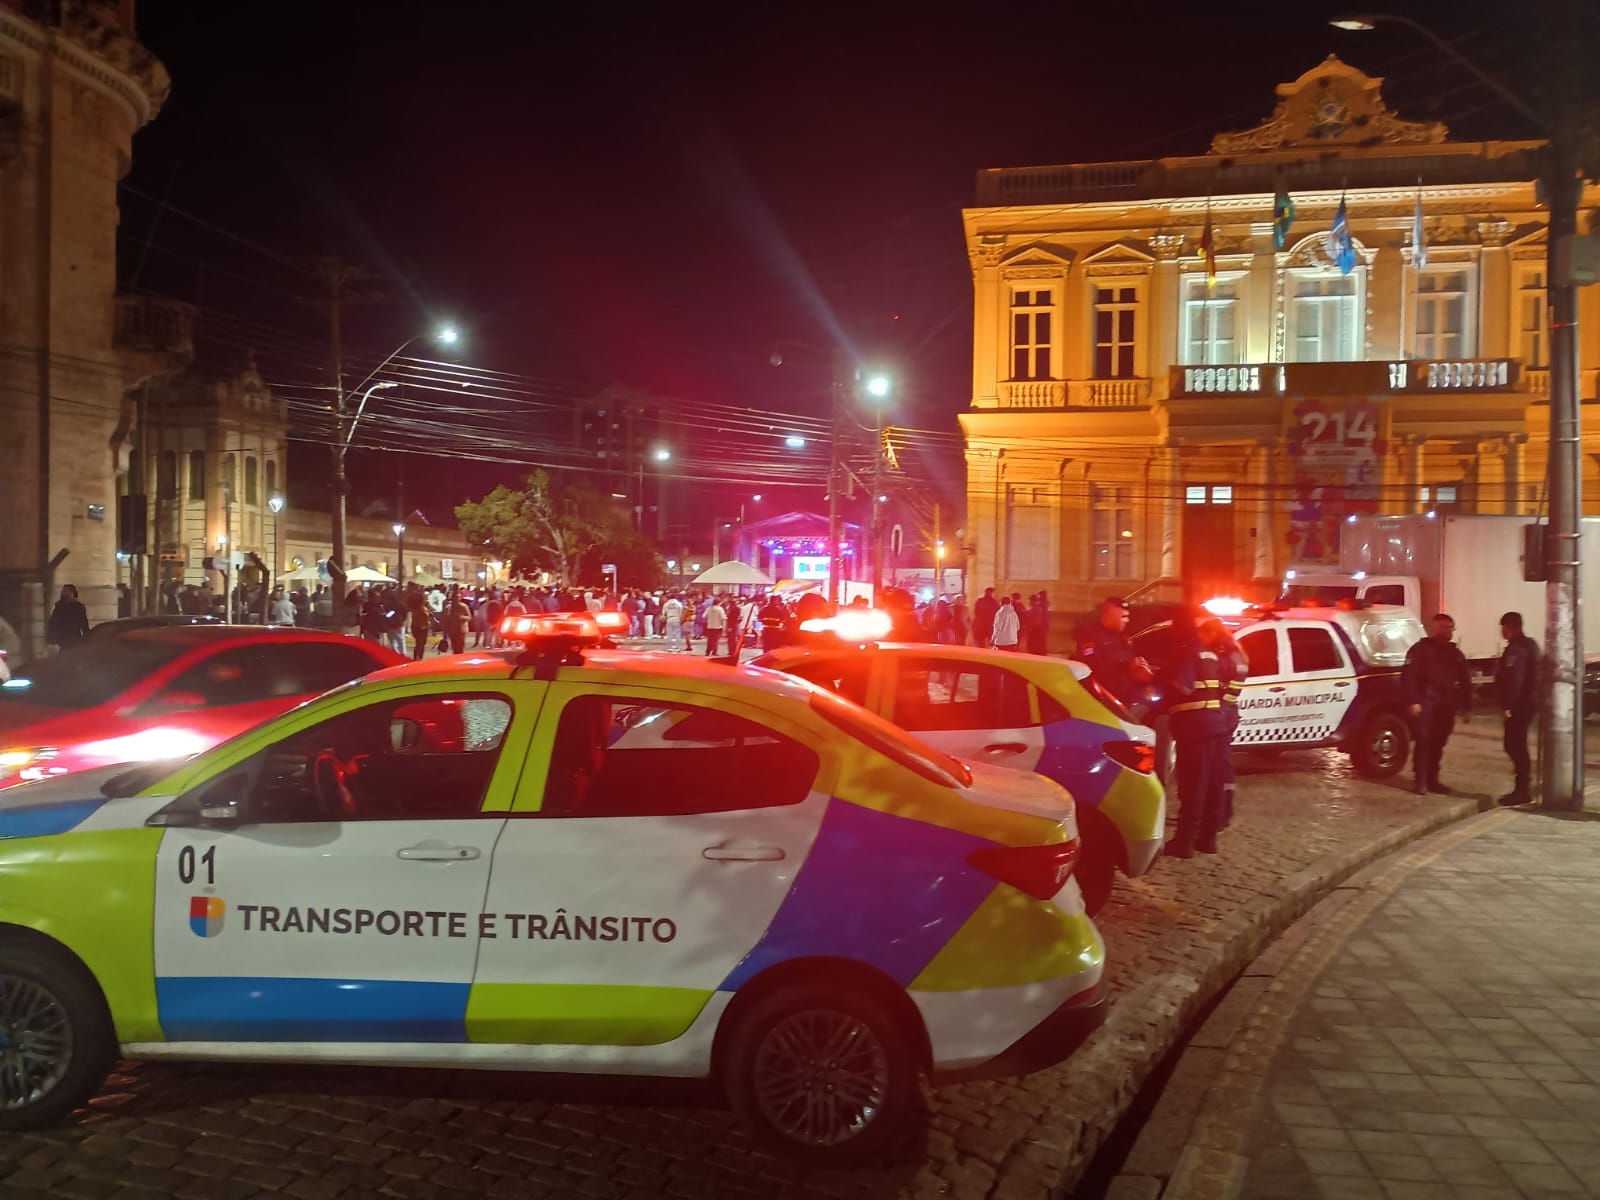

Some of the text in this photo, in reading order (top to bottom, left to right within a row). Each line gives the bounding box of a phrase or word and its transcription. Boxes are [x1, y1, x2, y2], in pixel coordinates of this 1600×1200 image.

[1302, 410, 1377, 446] 214
[1240, 692, 1345, 709] UARDA MUNICIPAL
[178, 845, 217, 884] 01
[237, 905, 677, 943] TRANSPORTE E TRÂNSITO
